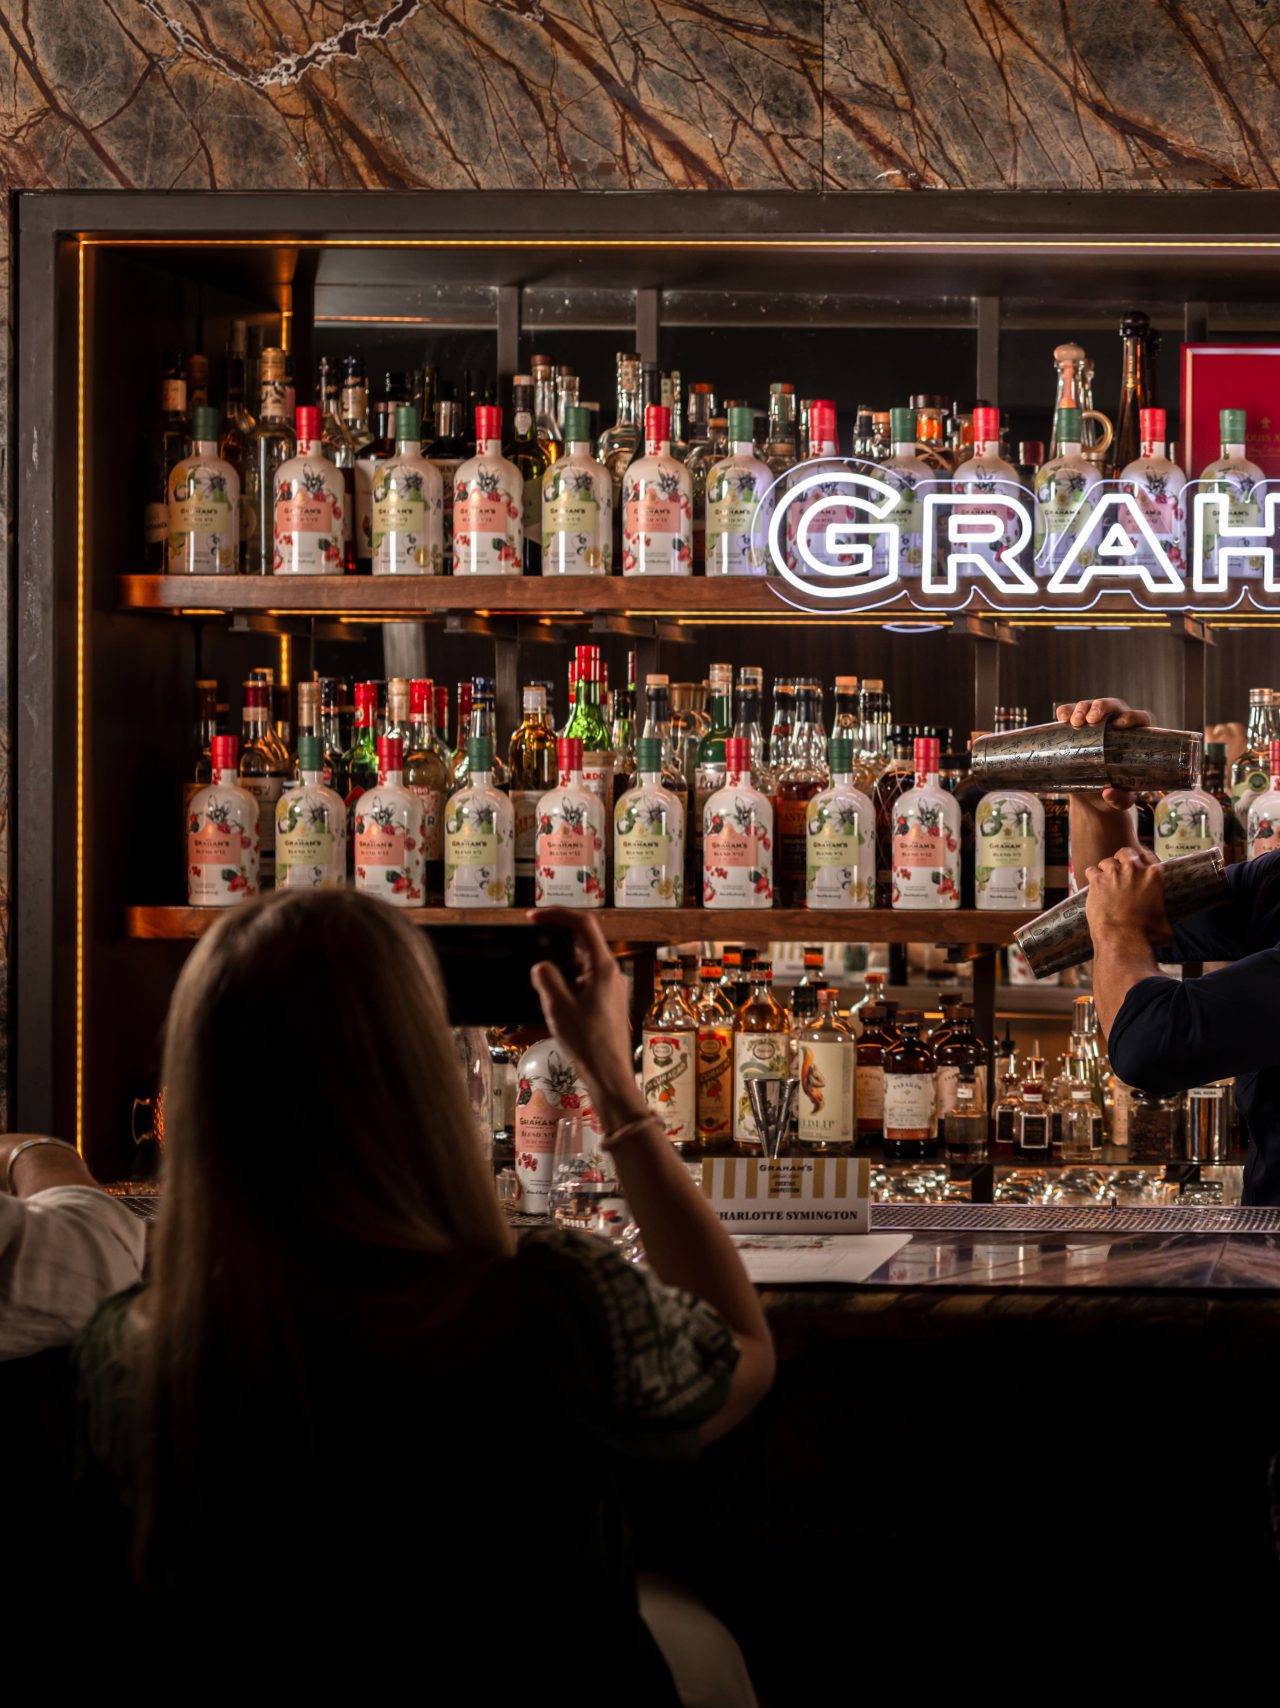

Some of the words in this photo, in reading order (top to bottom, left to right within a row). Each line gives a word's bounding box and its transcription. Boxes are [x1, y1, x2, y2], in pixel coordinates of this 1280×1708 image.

[519, 1117, 557, 1126] GRAHAM
[759, 1164, 813, 1172] GRAHAM'S
[785, 1211, 858, 1221] SYMINGTON
